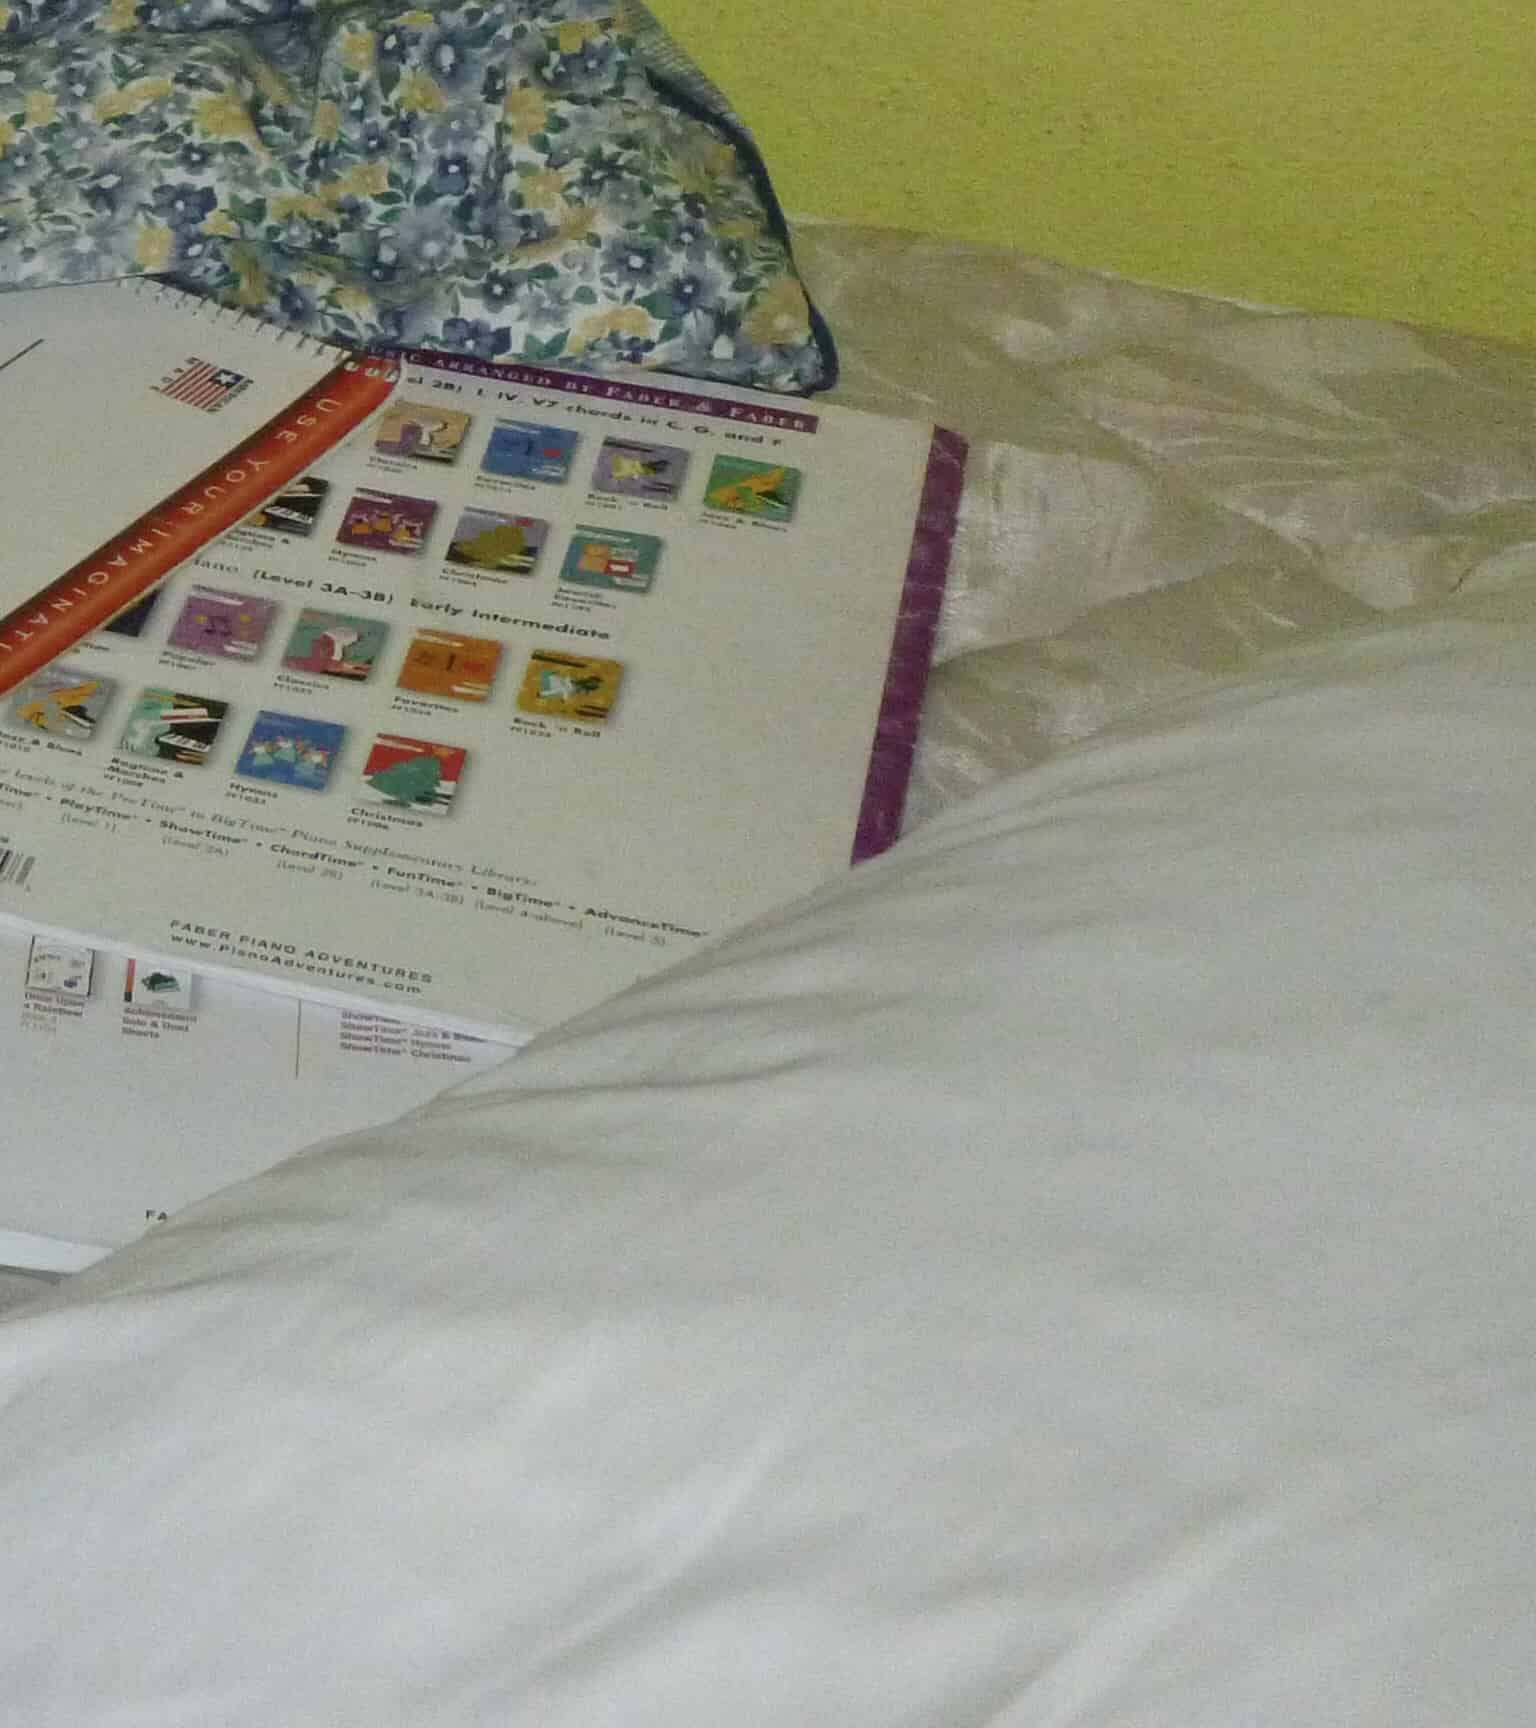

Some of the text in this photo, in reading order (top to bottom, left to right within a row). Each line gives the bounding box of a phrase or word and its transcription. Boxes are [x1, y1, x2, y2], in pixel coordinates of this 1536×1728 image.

[274, 398, 343, 443] USE
[181, 458, 271, 515] YOUR
[252, 569, 313, 590] (Level
[319, 582, 394, 605] 3A-3B)
[410, 597, 463, 617] Early
[471, 609, 611, 641] Intermediate
[351, 806, 424, 828] Christmas
[169, 919, 434, 984] FABER PIANO ADVENTURES
